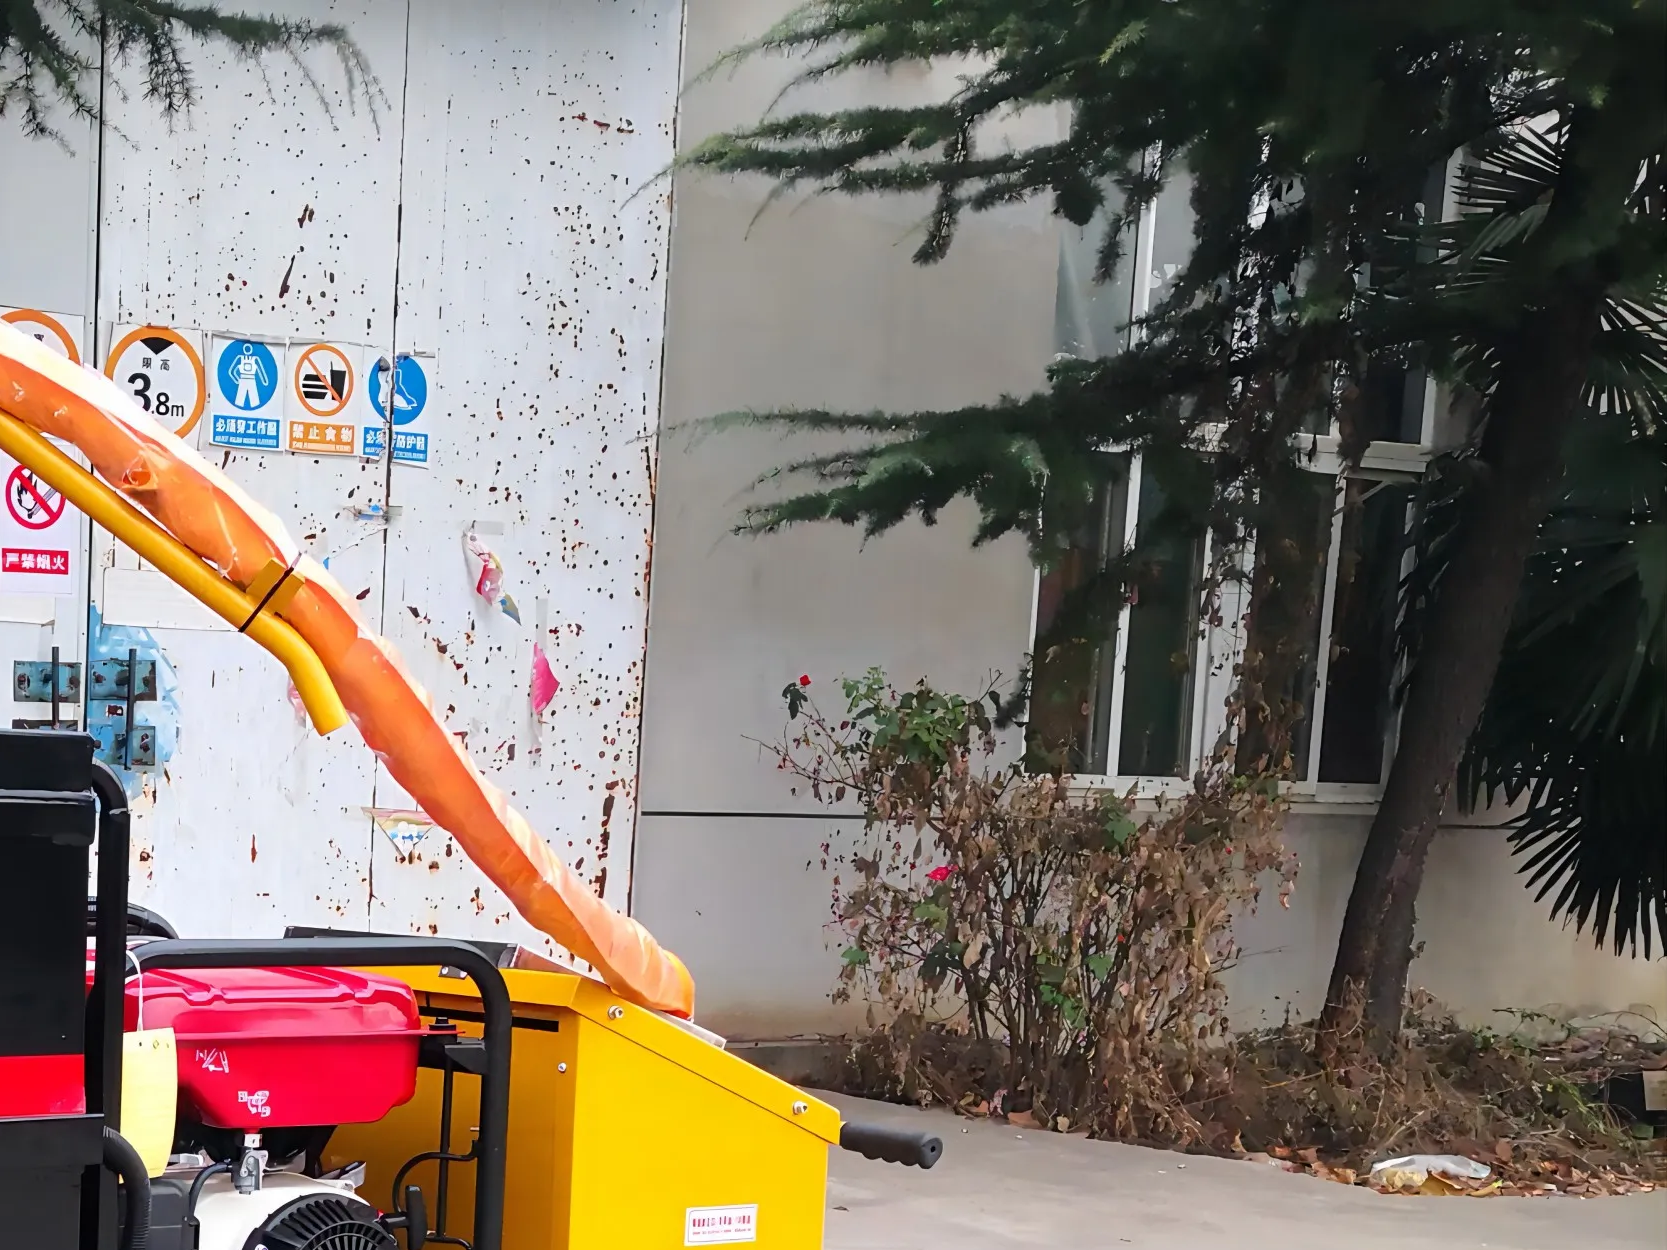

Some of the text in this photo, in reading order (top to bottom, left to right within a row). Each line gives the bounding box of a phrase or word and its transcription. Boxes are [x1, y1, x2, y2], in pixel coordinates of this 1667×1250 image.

[141, 356, 171, 371] 限高
[127, 372, 184, 417] 3.8m
[215, 417, 277, 436] 必须穿工作服
[5, 552, 66, 571] 严禁烟火
